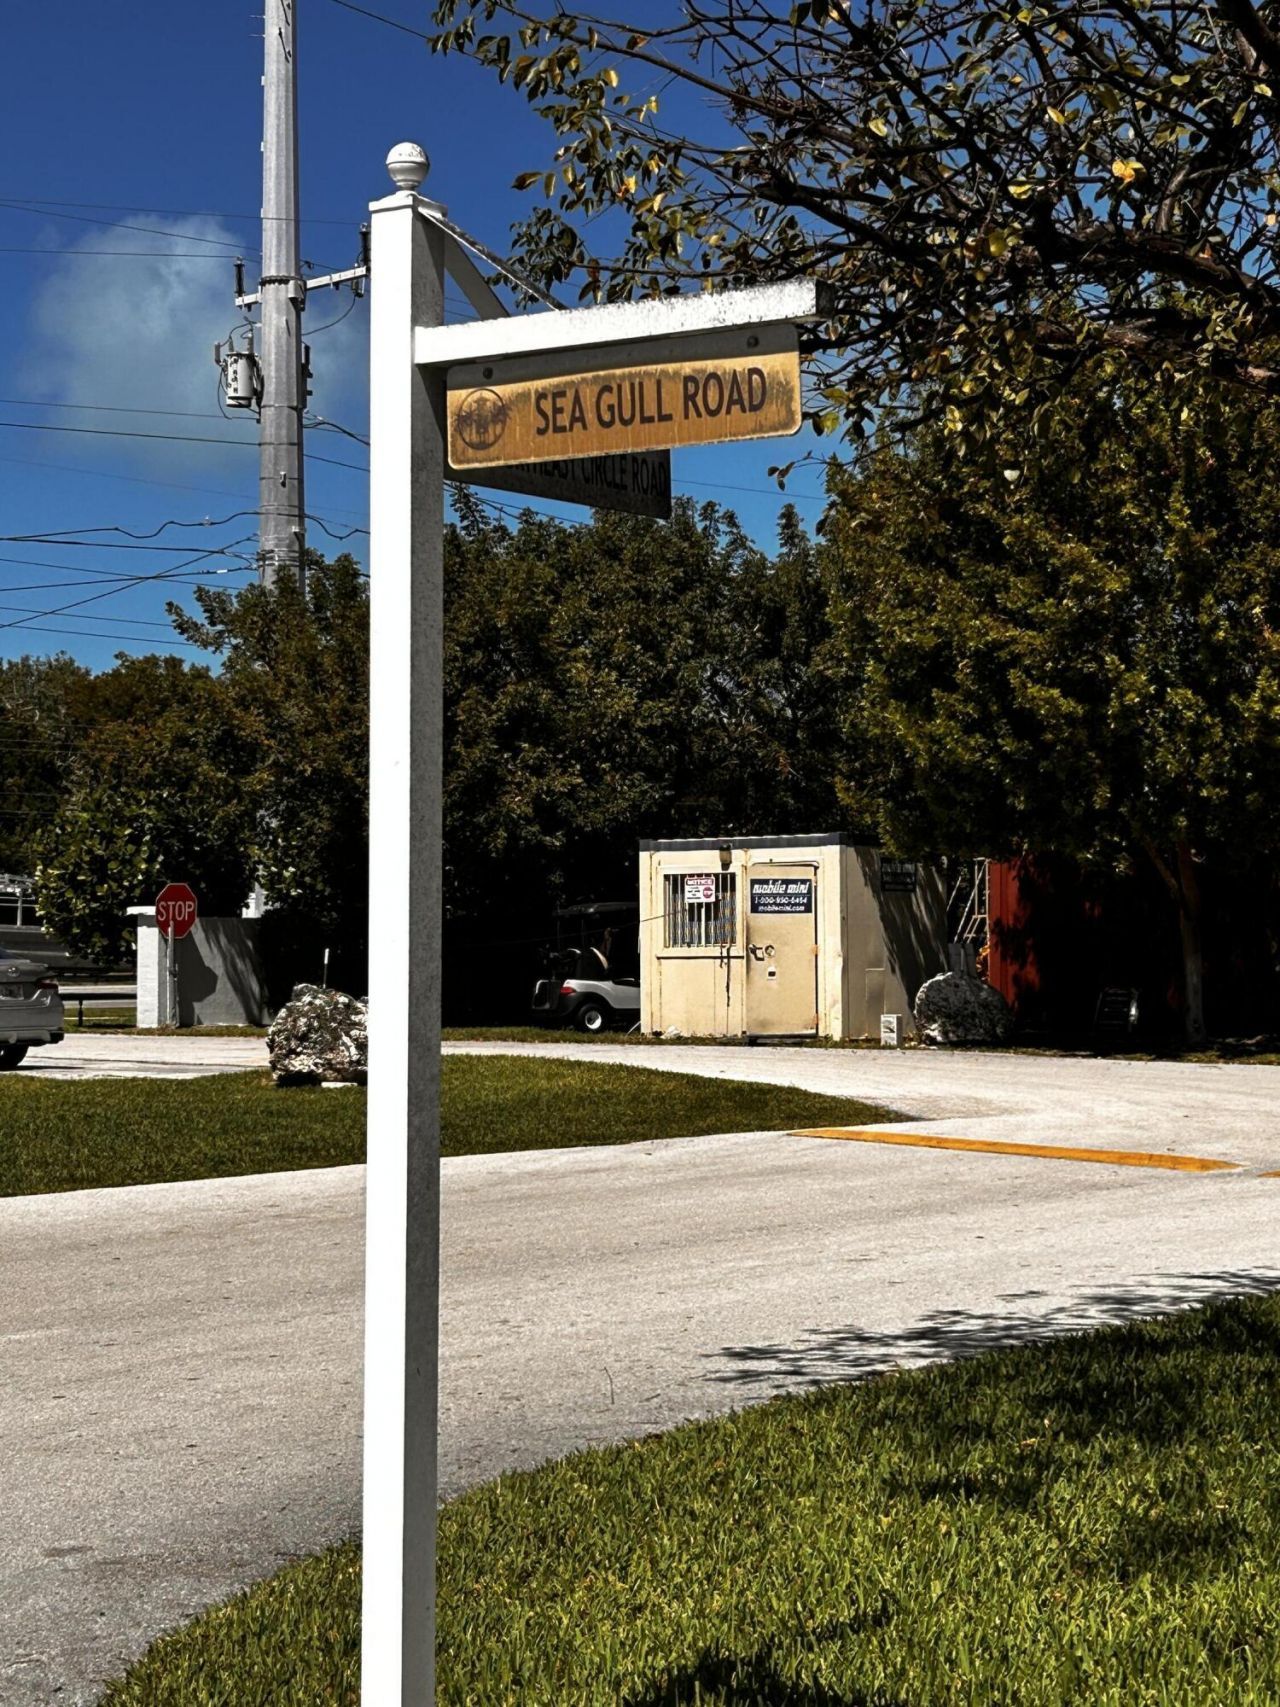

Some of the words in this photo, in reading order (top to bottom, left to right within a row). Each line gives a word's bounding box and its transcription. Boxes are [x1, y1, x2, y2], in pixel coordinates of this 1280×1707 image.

[535, 388, 588, 436] SEA
[595, 379, 673, 429] GULL
[683, 367, 767, 420] ROAD
[582, 453, 628, 490] CIRCLE
[632, 455, 668, 495] ROAD
[752, 879, 786, 894] mobile
[786, 881, 810, 894] mini
[157, 901, 195, 921] STOP
